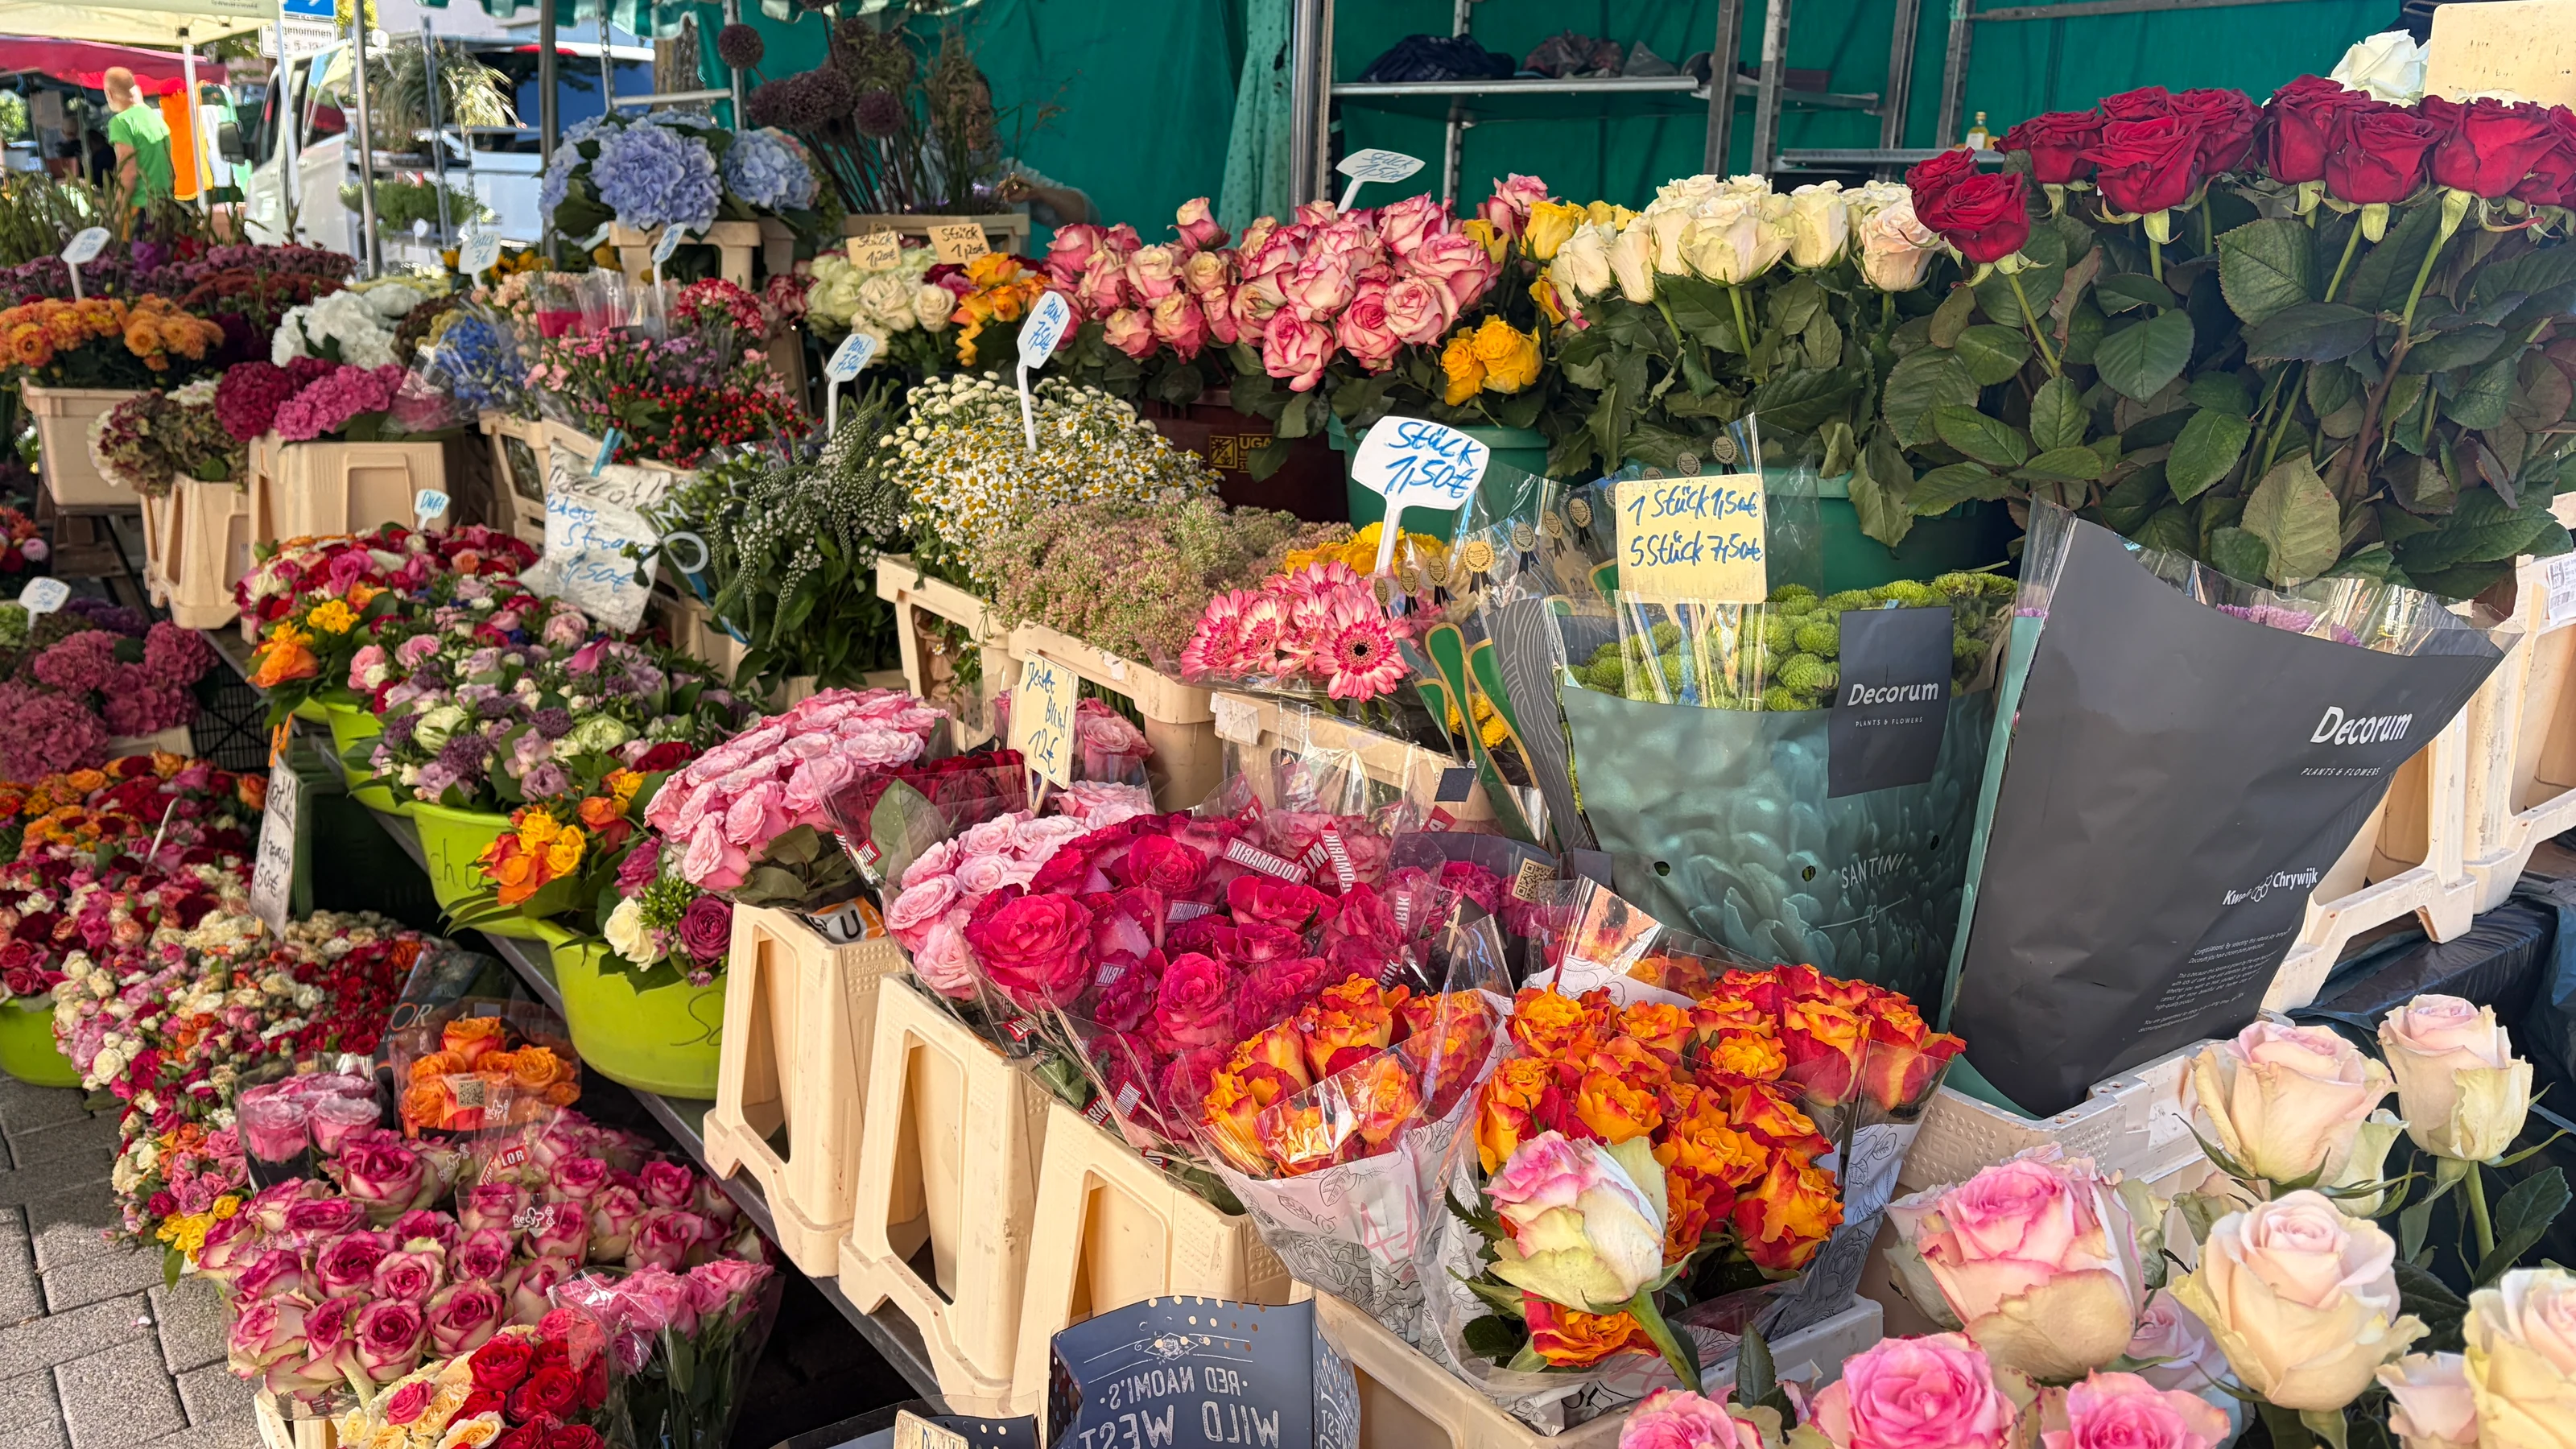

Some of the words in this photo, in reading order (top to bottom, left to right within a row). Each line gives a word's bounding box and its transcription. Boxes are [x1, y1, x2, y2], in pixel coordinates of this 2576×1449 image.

[857, 233, 893, 248] Stück
[941, 226, 979, 242] Stück
[1388, 421, 1482, 467] Stück
[1385, 456, 1479, 499] 1,50€
[1627, 495, 1645, 526] 1
[1651, 485, 1709, 519] Stück
[1630, 535, 1645, 567] 5
[1847, 683, 1939, 707] Decorum
[1856, 719, 1881, 727] PLANTS
[1892, 716, 1923, 725] FLOWERS
[2310, 706, 2413, 745] Decorum
[1028, 728, 1059, 774] 12€
[2301, 767, 2335, 776] PLANTS
[2344, 767, 2380, 776] FLOWERS
[1841, 852, 1906, 889] SANTINI
[2273, 867, 2318, 890] Chrywijk
